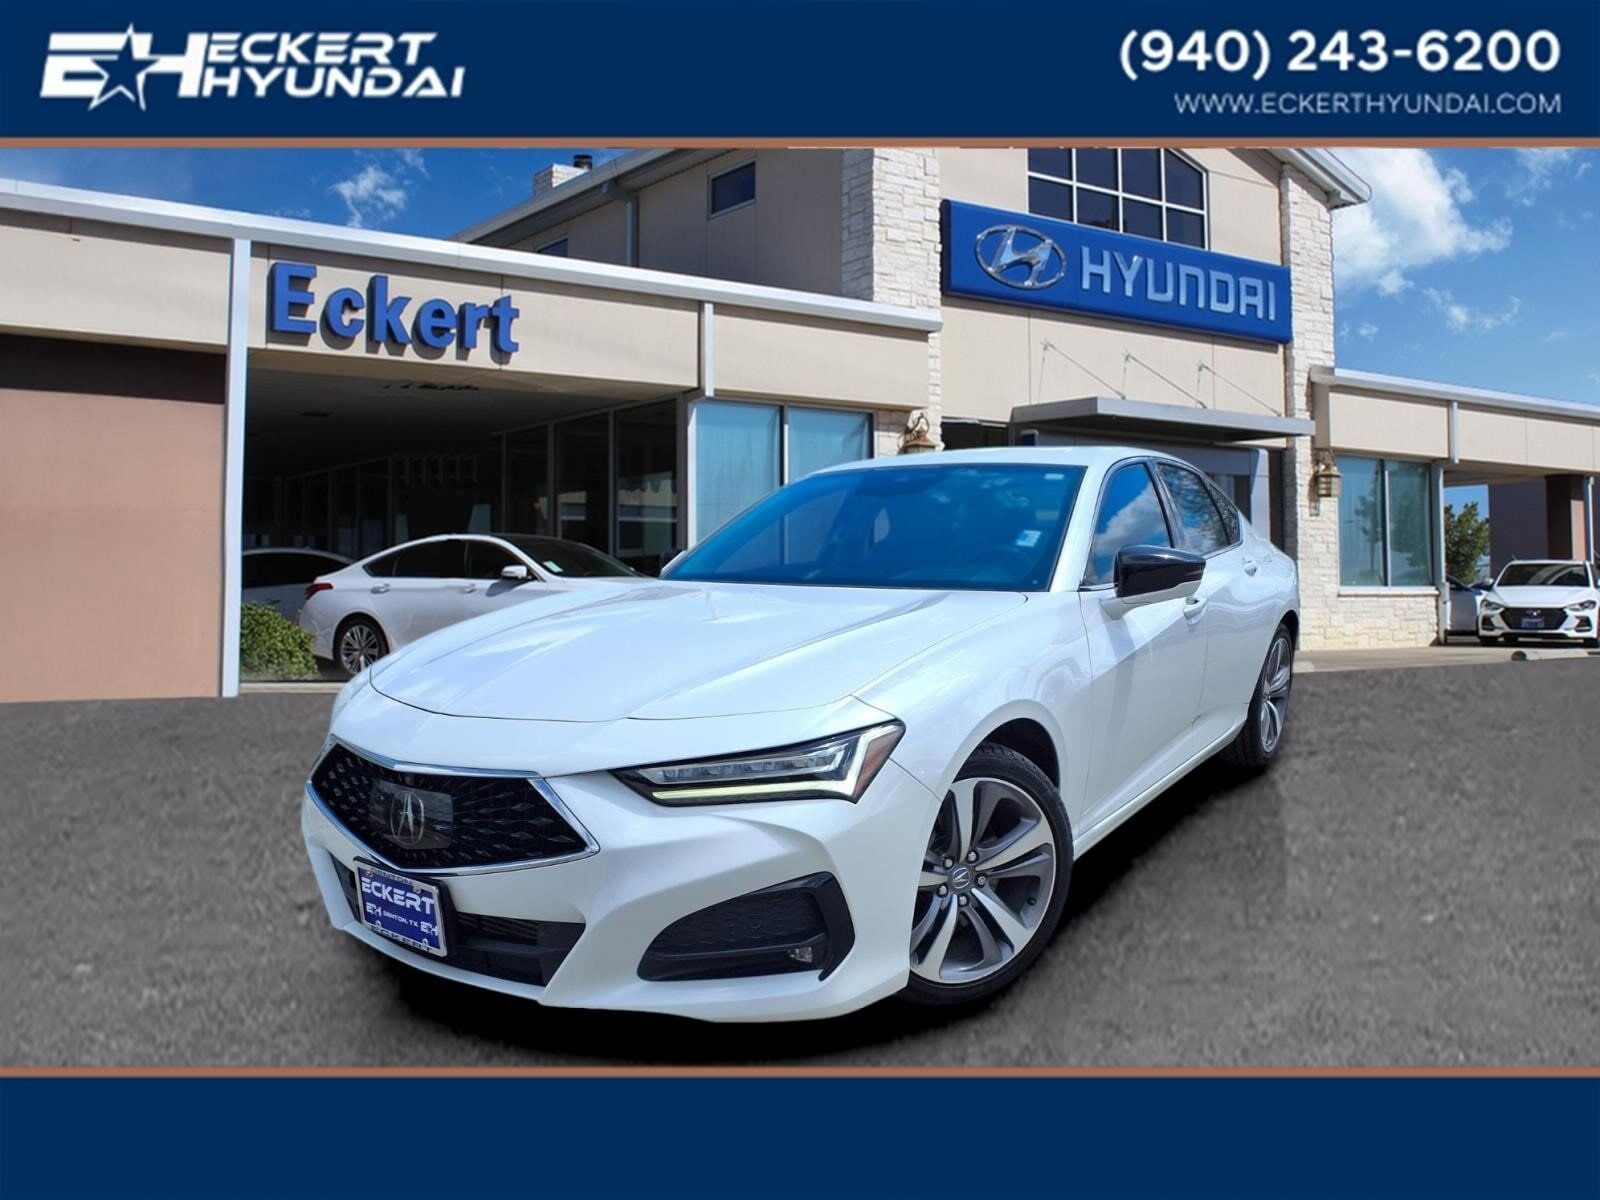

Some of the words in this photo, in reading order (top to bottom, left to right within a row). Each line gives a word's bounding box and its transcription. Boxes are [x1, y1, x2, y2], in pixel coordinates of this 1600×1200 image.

[268, 261, 520, 353] Eckert
[1081, 246, 1276, 322] HYUNDAI
[361, 877, 434, 914] ECKERT
